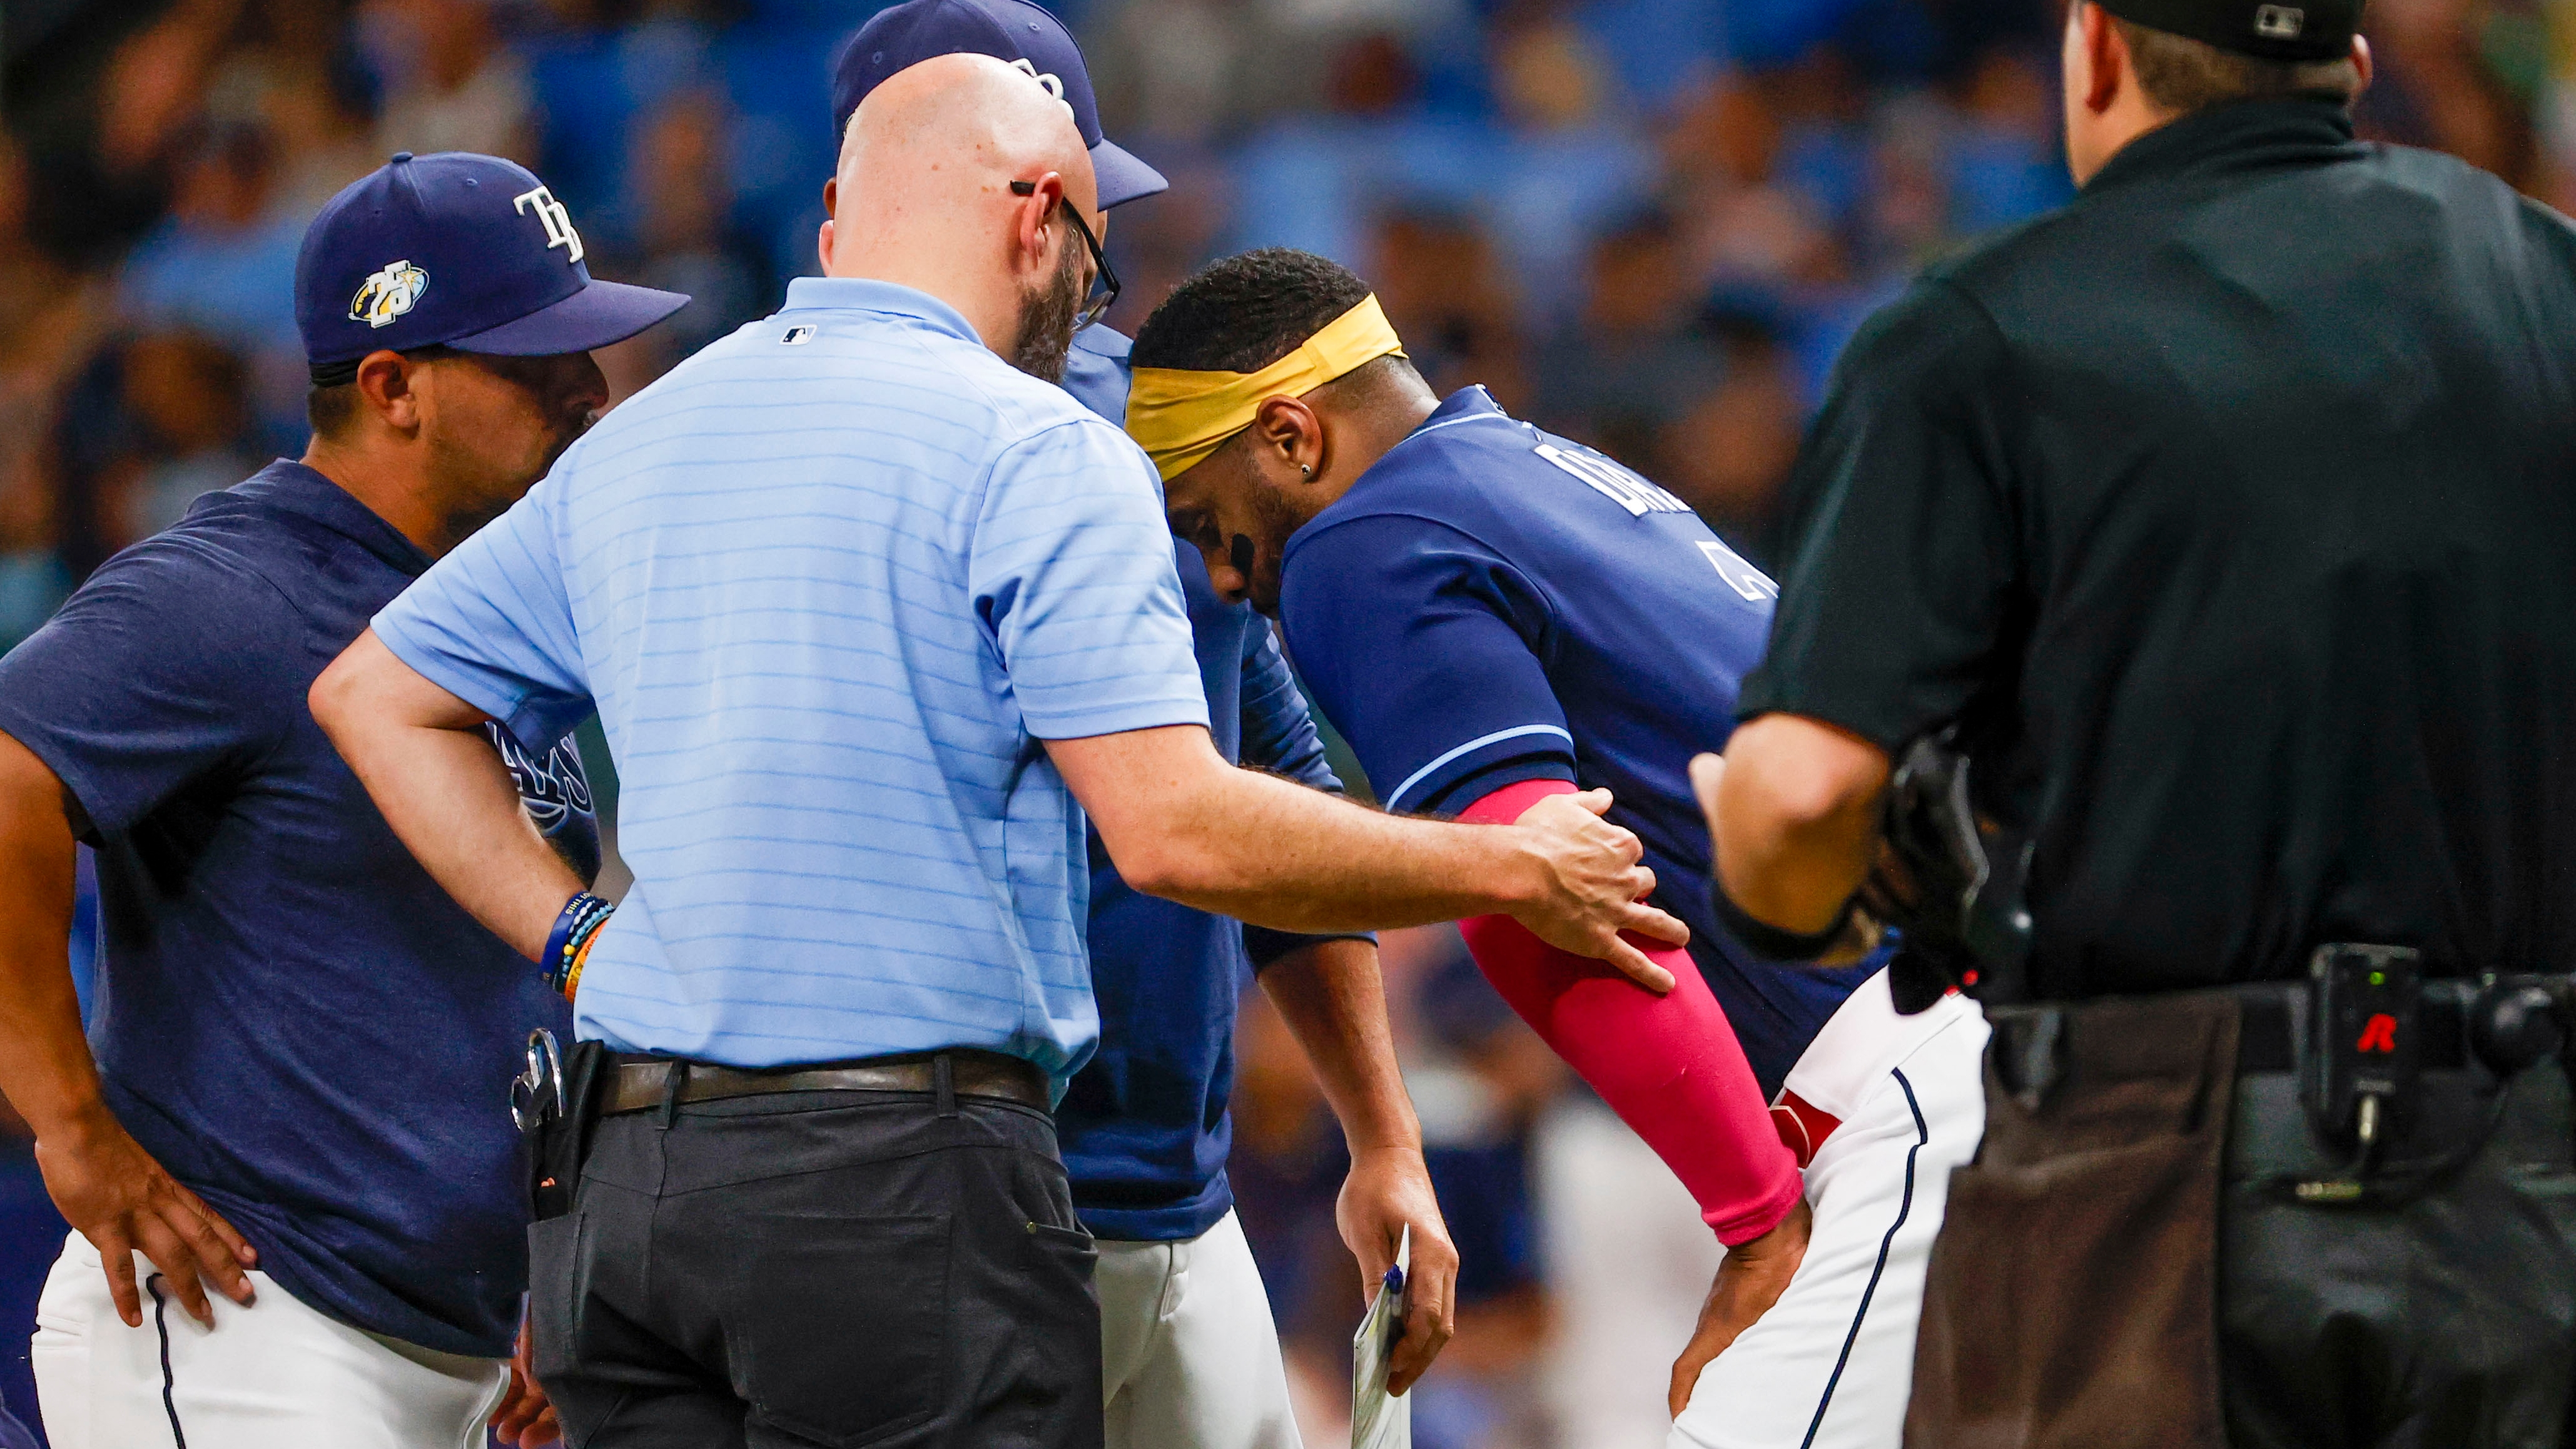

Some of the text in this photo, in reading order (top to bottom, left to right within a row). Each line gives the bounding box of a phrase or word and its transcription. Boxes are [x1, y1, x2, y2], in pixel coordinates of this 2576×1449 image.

[513, 185, 584, 263] TB
[366, 259, 413, 328] 25
[565, 898, 583, 915] THIS
